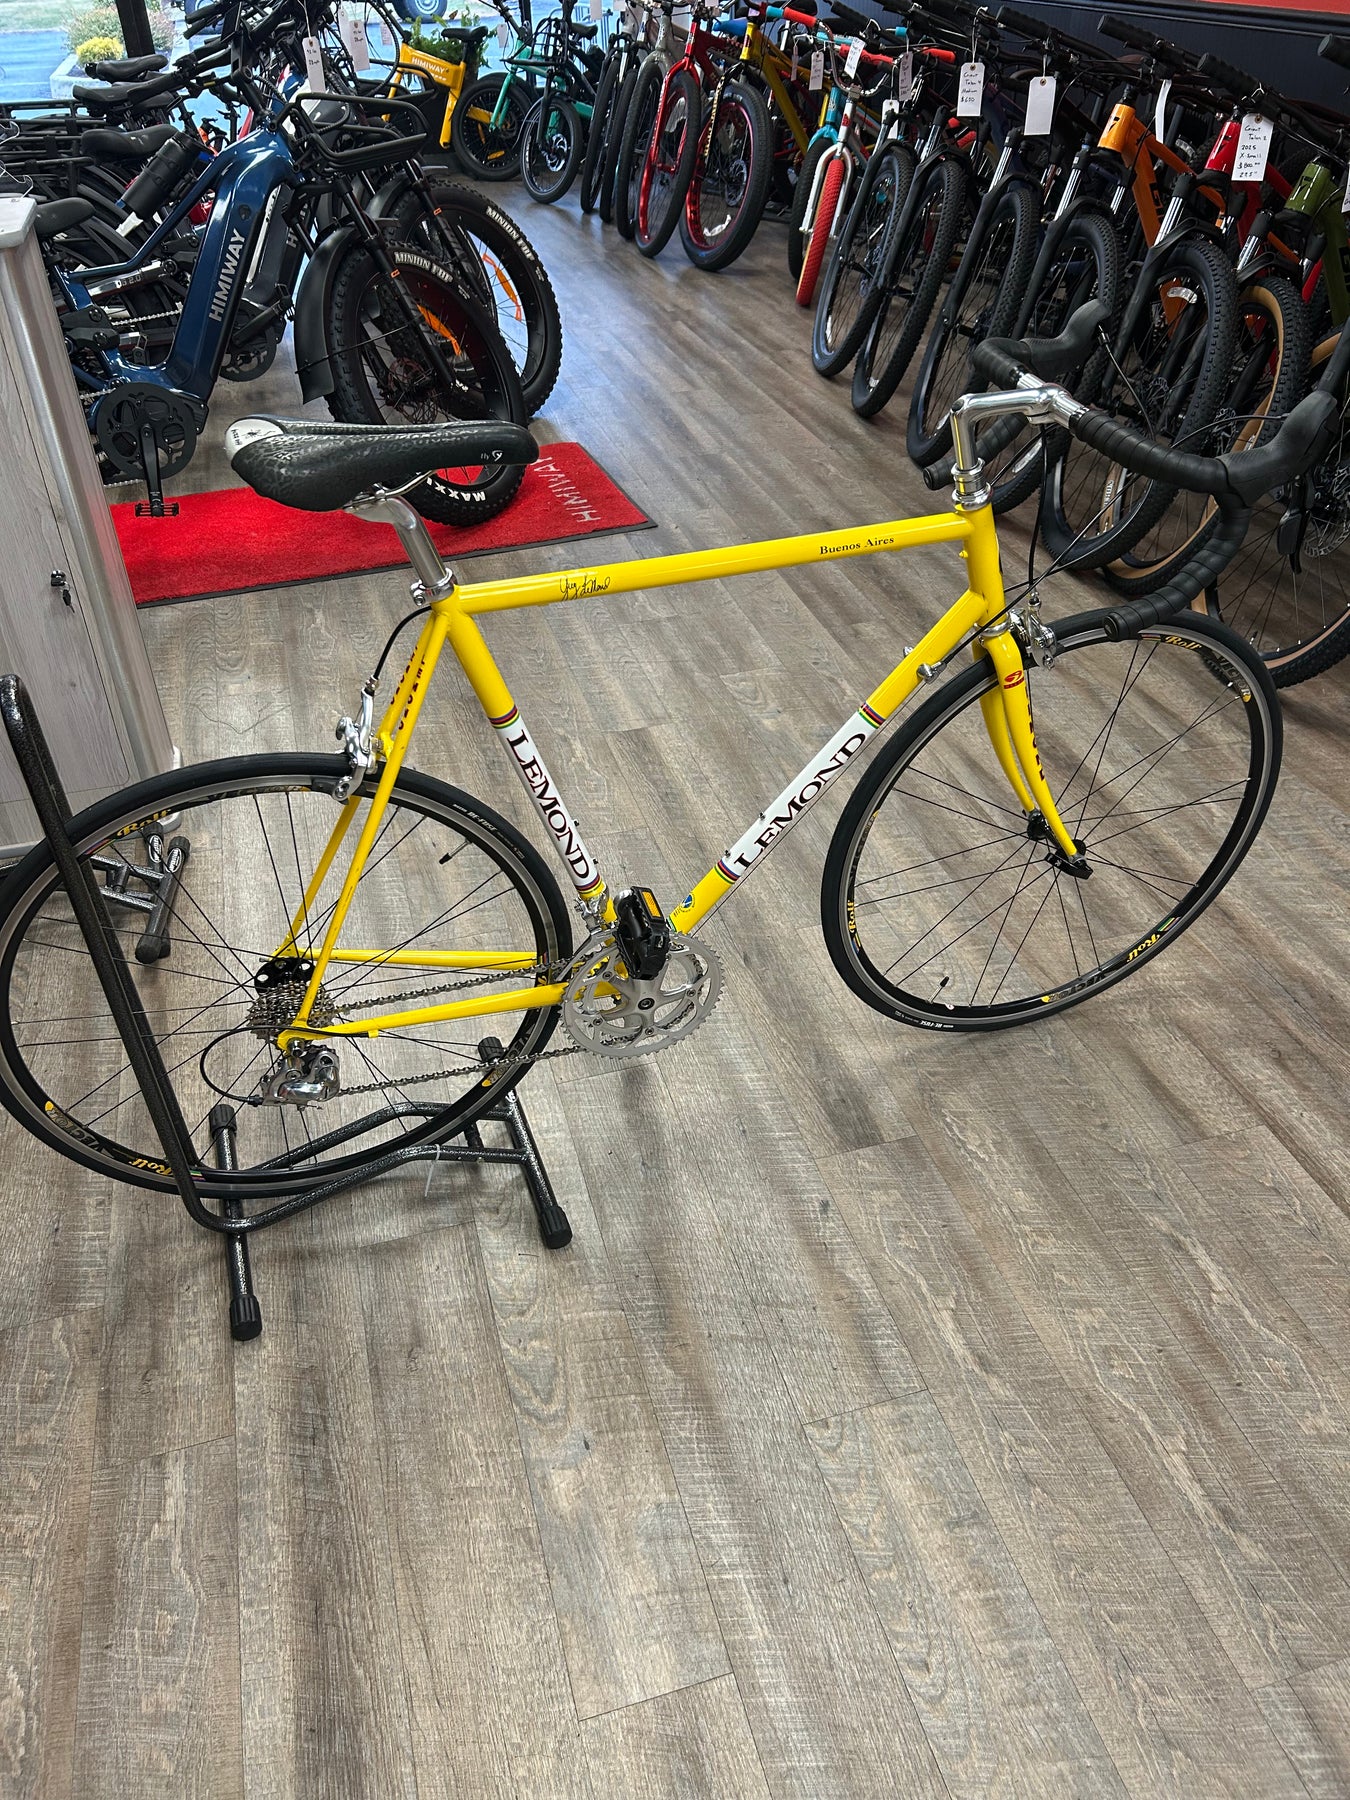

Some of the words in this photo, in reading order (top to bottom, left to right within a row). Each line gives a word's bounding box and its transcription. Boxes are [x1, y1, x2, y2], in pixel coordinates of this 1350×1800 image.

[411, 57, 445, 73] HIMIWAY
[486, 206, 520, 241] MINION
[208, 228, 246, 322] HIMIWAY
[394, 251, 431, 270] MINION
[416, 471, 486, 502] MAXXI
[819, 542, 861, 555] Buenos
[864, 537, 895, 548] Aires
[1165, 635, 1202, 650] Rolf
[506, 729, 590, 880] LEMOND
[733, 732, 867, 871] LEMOND
[117, 808, 171, 837] Rolf
[847, 900, 856, 934] Rolf
[1127, 934, 1160, 963] Rolf
